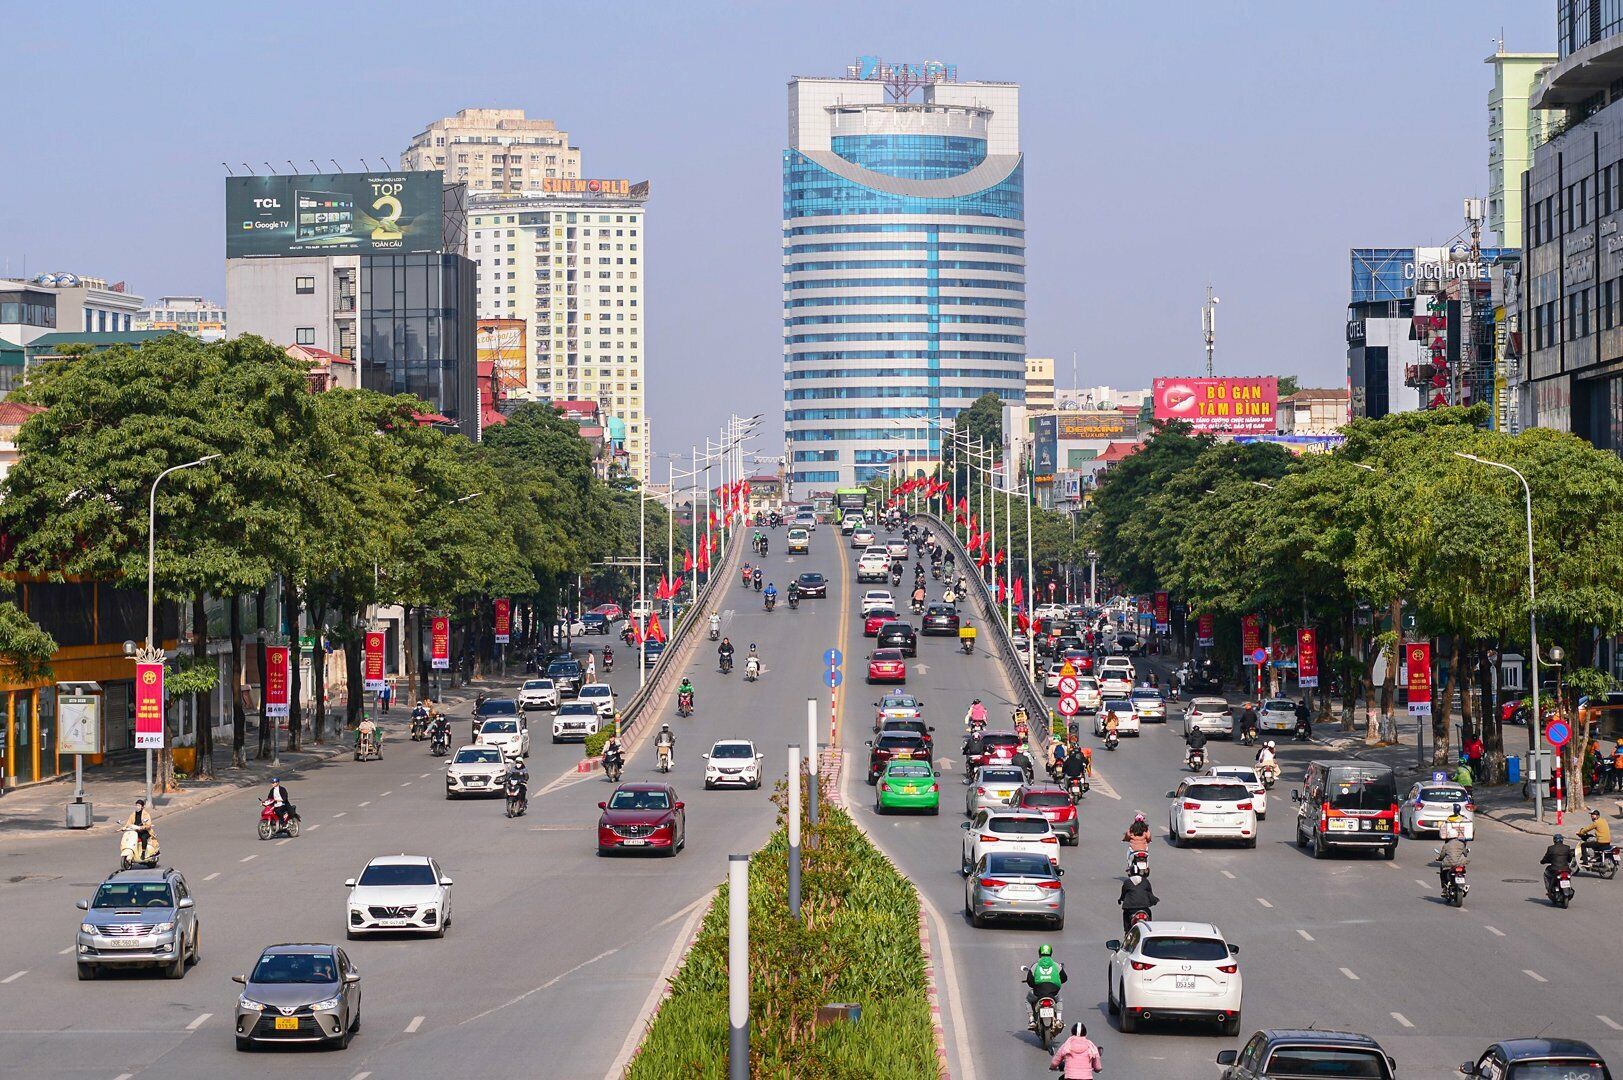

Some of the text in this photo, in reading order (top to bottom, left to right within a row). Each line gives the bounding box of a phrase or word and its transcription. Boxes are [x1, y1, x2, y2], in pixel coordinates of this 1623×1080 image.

[371, 183, 403, 196] TOP
[543, 178, 629, 194] SUN WORLD
[253, 199, 281, 208] TCL
[255, 221, 279, 230] Google
[371, 195, 403, 240] 2
[1404, 263, 1492, 280] CoCo HOTEL
[1349, 322, 1364, 338] OTEL
[1207, 380, 1262, 400] BỔ GAN
[1199, 399, 1270, 416] TÂM BÌNH
